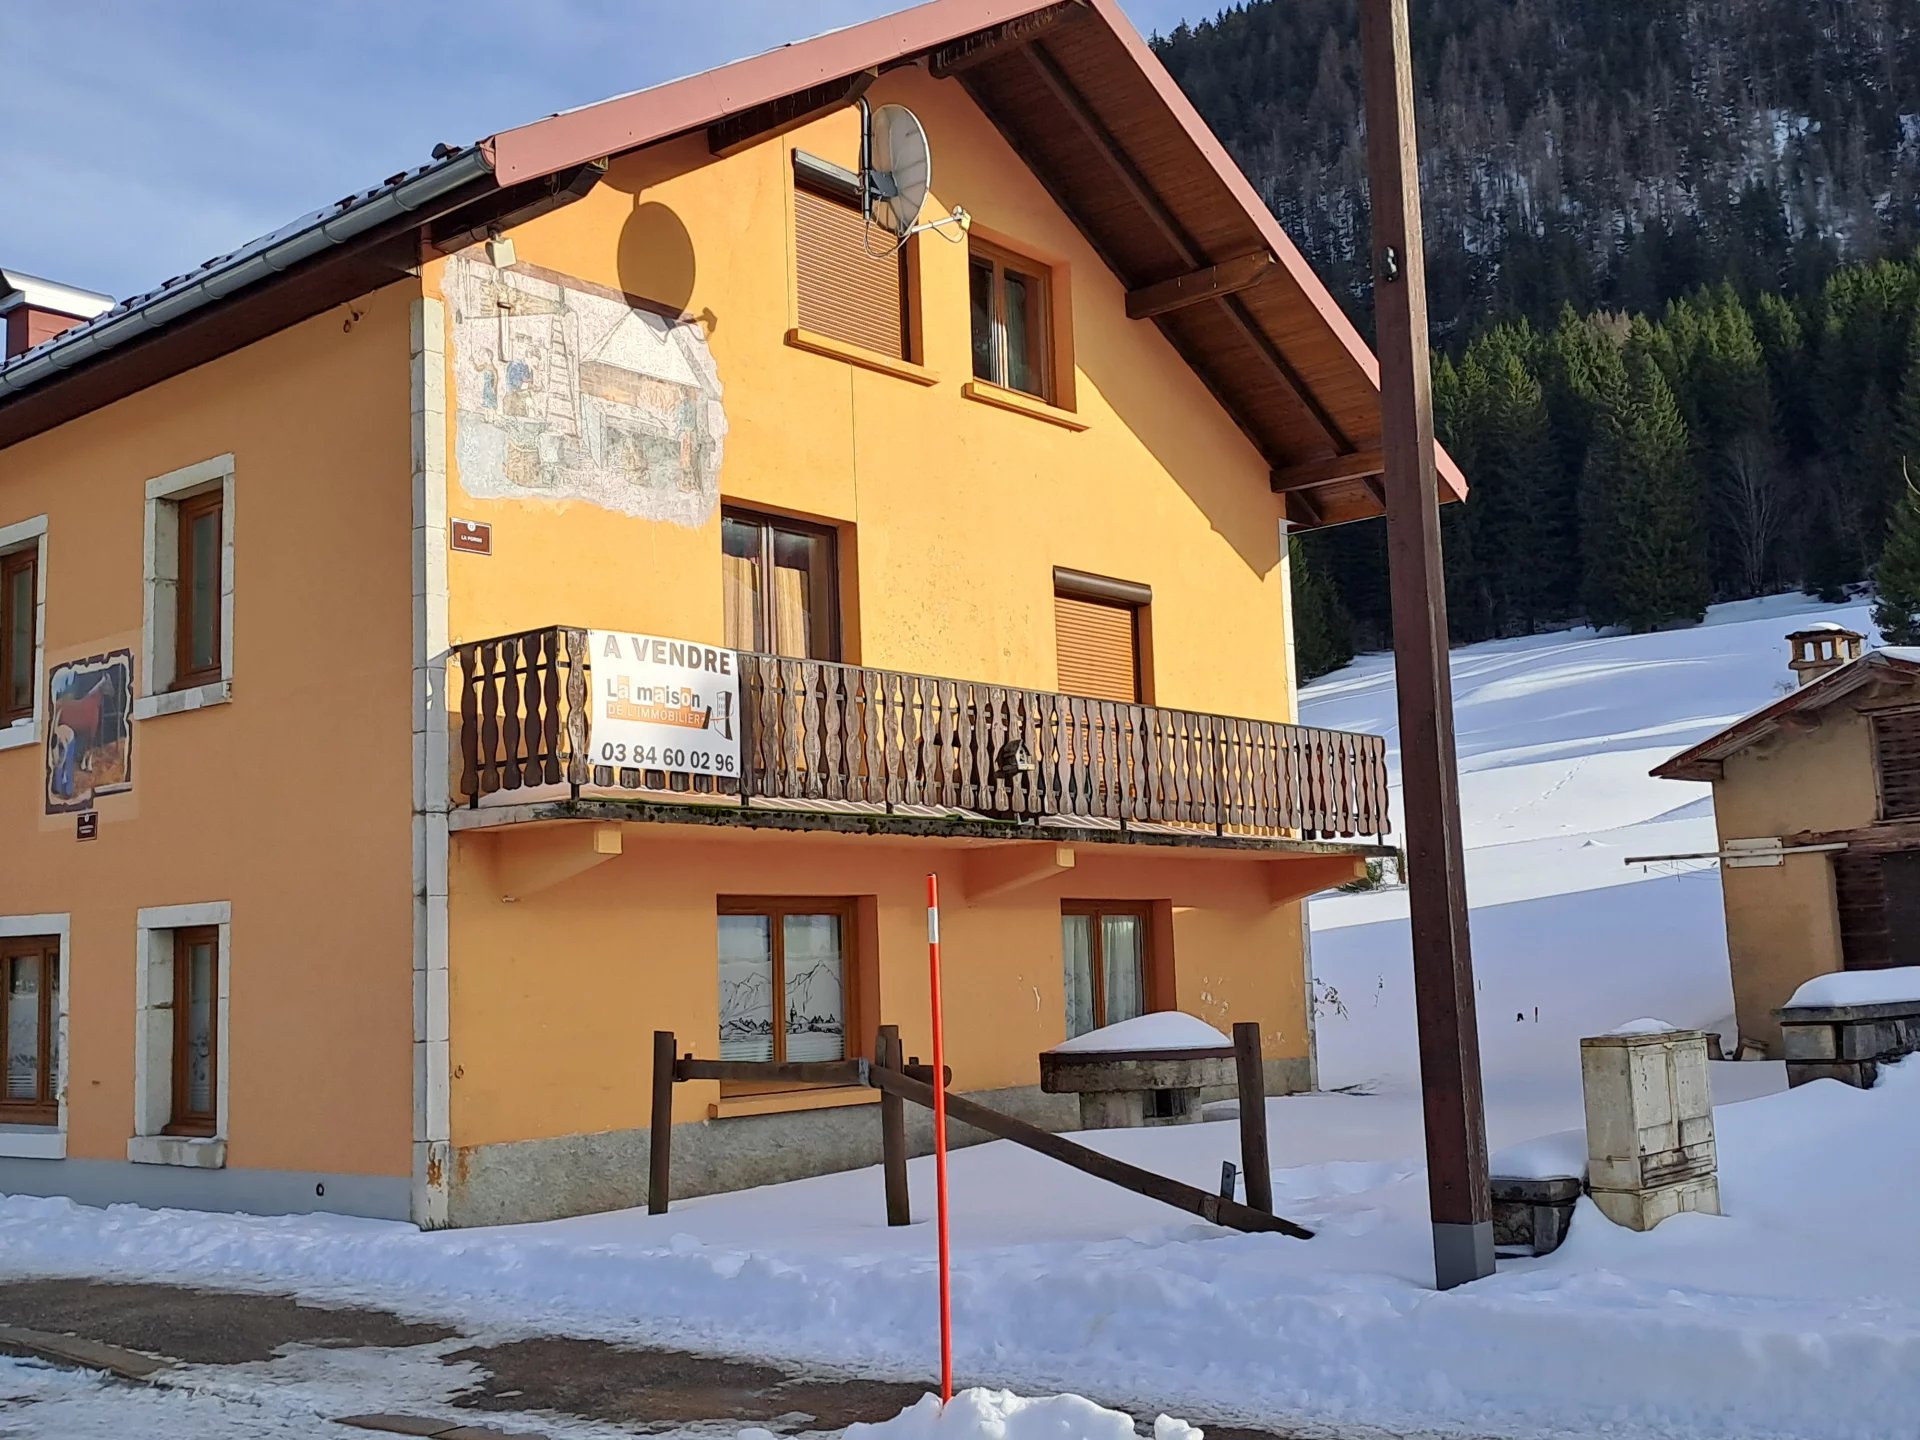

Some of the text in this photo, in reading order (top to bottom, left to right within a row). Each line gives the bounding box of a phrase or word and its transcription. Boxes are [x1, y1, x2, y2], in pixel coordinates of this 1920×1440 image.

[603, 635, 731, 676] A VENDRE
[607, 678, 701, 708] La maison
[608, 703, 700, 725] DE L'IMMOBILIER
[601, 743, 735, 773] 03 84 60 02 96
